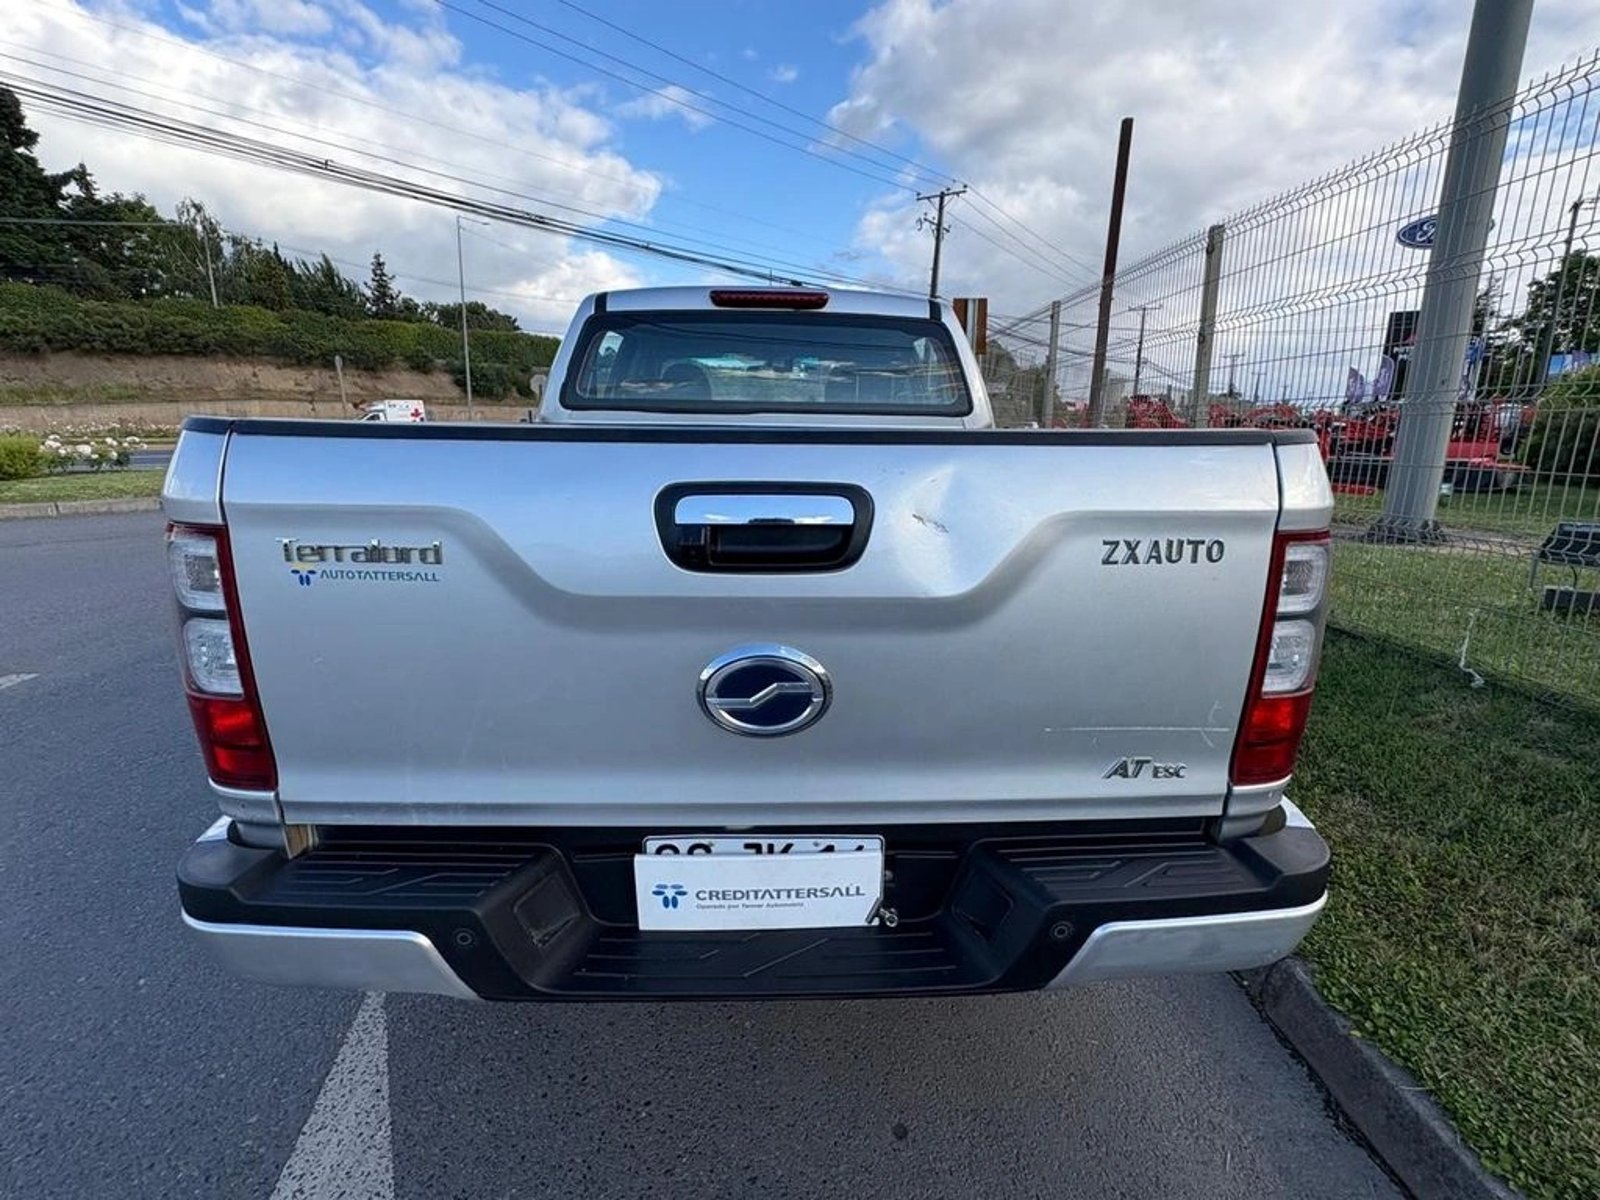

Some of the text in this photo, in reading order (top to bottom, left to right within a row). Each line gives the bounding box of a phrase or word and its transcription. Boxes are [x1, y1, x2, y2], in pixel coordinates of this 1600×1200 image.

[275, 537, 443, 565] Terralord
[1101, 537, 1225, 565] ZXAUTO
[320, 569, 440, 582] AUTOTATTERSALL
[1101, 756, 1187, 779] AT ESC
[695, 885, 866, 901] CREDITATTERSALL
